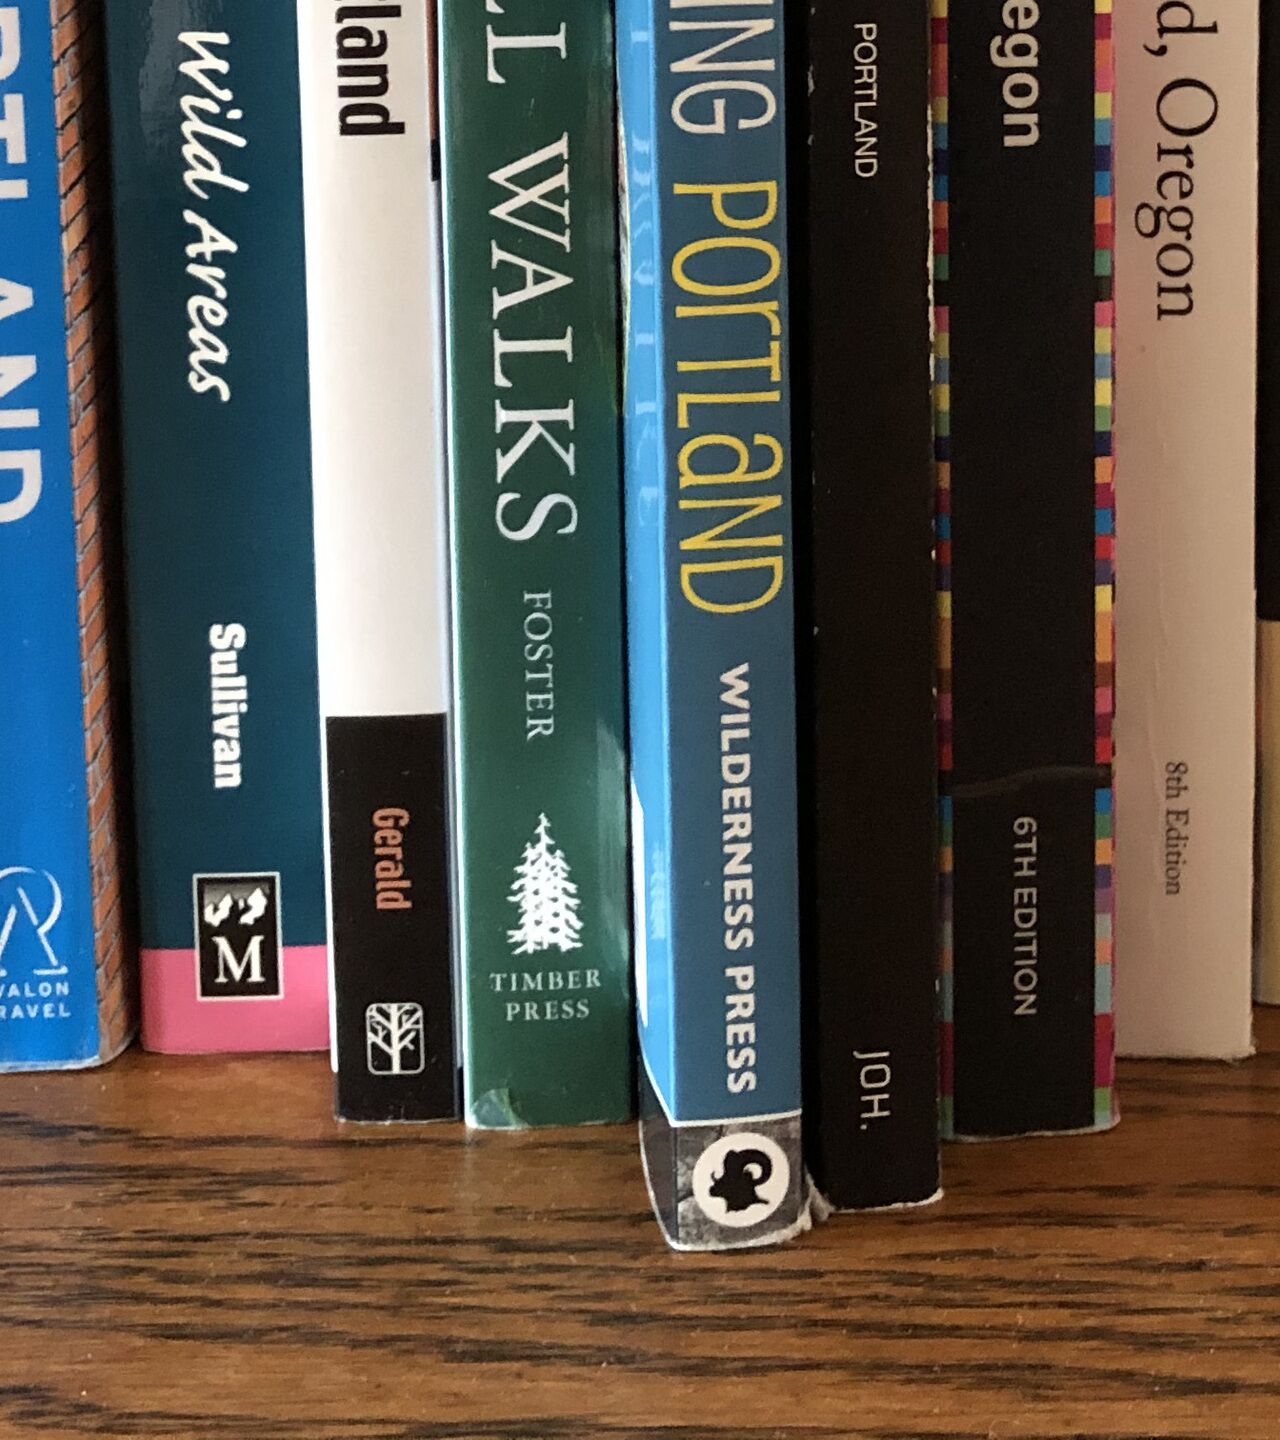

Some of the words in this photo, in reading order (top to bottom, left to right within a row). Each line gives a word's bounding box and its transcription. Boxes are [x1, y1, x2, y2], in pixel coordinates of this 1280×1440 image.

[177, 31, 250, 200] Wild
[854, 23, 877, 178] PORTLAND
[1134, 78, 1219, 321] Oregon
[182, 208, 239, 403] Areas
[487, 131, 579, 542] WALKS
[209, 623, 248, 789] Sullivan
[523, 589, 554, 741] FOSTER
[719, 662, 754, 951] WILDERNESS
[1166, 761, 1188, 798] 8th
[372, 807, 411, 911] Gerald
[1013, 816, 1037, 877] 6TH
[1166, 809, 1189, 895] Edition
[215, 936, 265, 983] M
[490, 969, 602, 992] TIMBER
[506, 999, 589, 1022] PRESS
[1013, 888, 1037, 1017] EDITION
[725, 965, 756, 1093] PRESS
